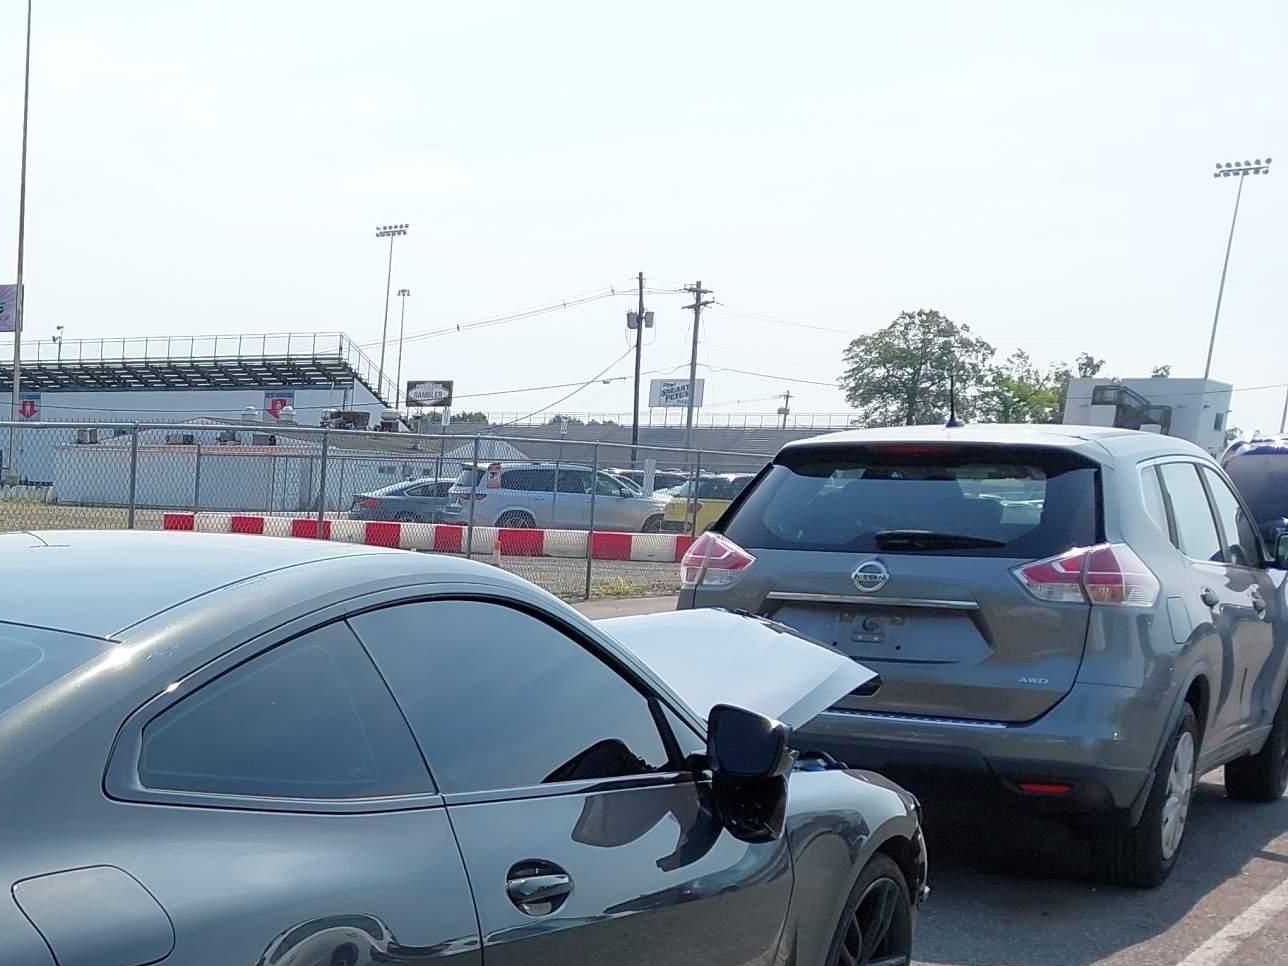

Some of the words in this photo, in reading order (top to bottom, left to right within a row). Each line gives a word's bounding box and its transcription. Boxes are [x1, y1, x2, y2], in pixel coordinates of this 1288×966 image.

[414, 391, 443, 399] GAMBLER
[854, 573, 887, 581] NISSAN
[1018, 676, 1049, 685] AWD
